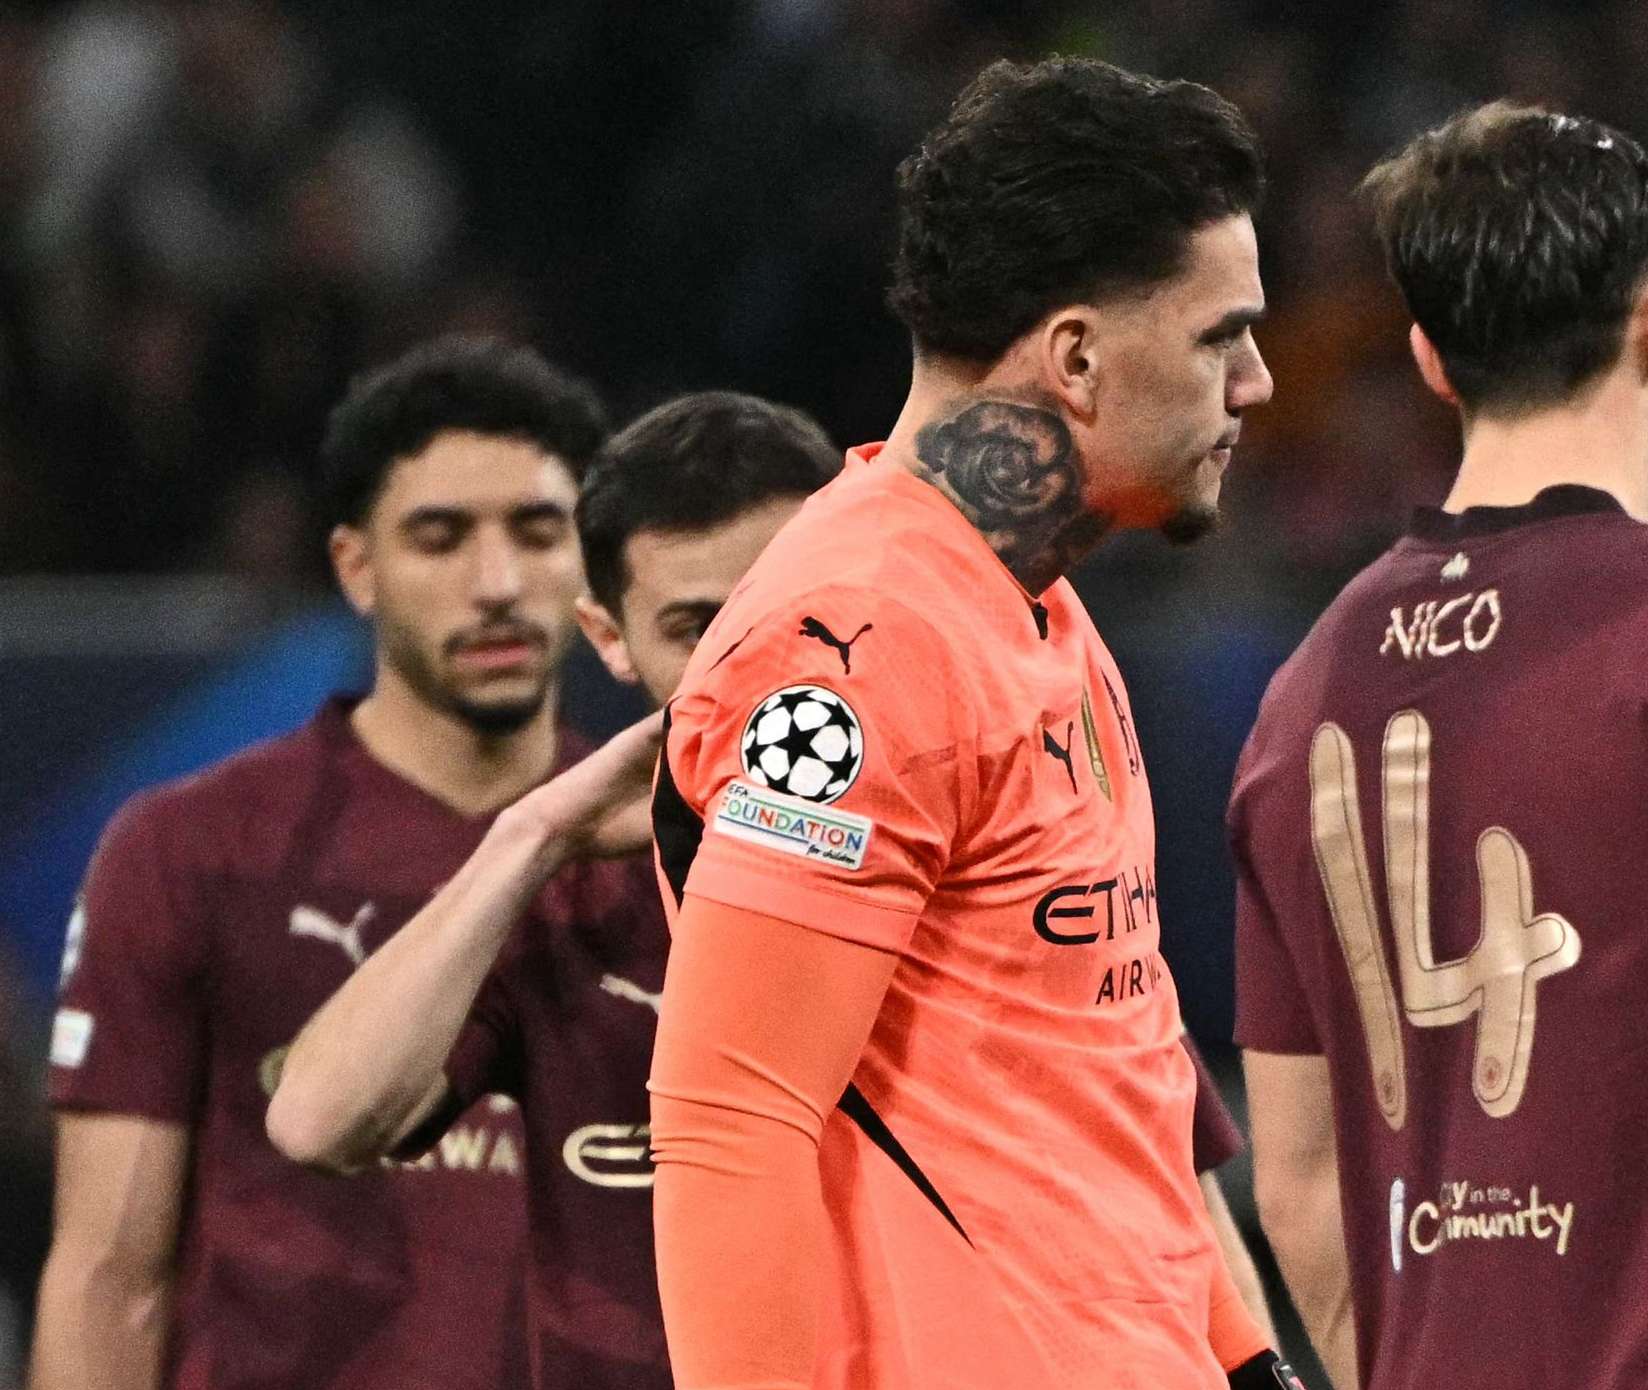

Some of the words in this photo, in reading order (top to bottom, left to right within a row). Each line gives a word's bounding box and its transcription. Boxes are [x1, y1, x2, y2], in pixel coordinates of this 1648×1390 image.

[1379, 589, 1502, 661] NICO
[728, 783, 748, 798] EFA
[721, 796, 863, 851] OUNDATION
[1309, 709, 1583, 1131] 14
